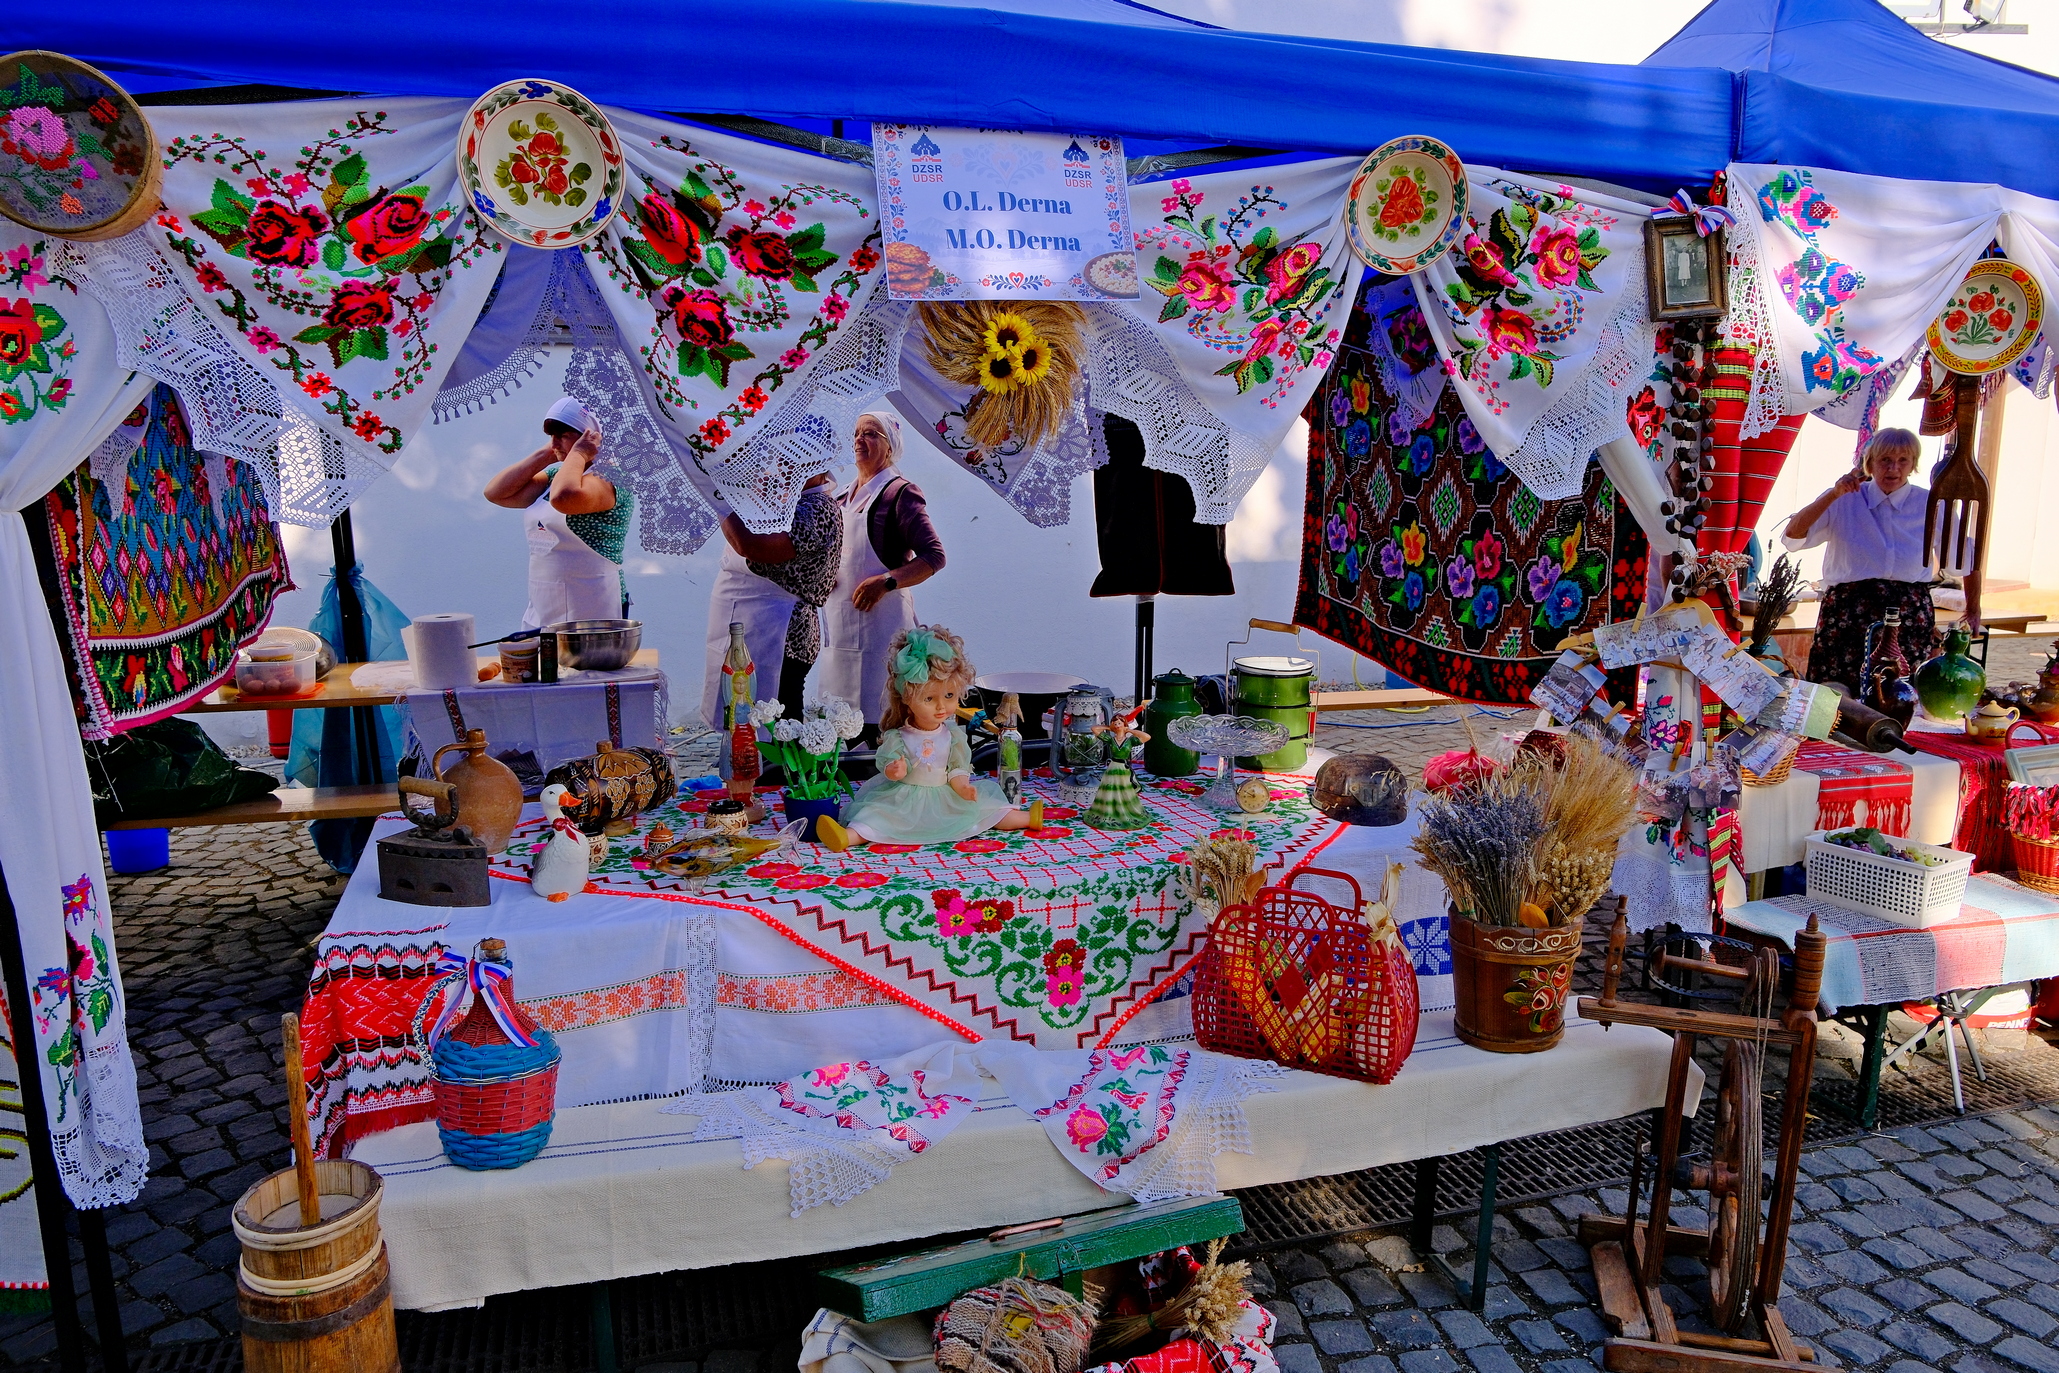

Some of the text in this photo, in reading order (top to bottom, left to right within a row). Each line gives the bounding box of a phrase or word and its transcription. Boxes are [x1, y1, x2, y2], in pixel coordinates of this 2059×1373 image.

[912, 164, 943, 173] DZSR
[913, 174, 944, 183] UDSR
[1064, 169, 1092, 179] DZSR
[1065, 179, 1093, 189] UDSR
[942, 190, 1073, 215] O.L. Derna
[944, 228, 1083, 252] M.O. Derna
